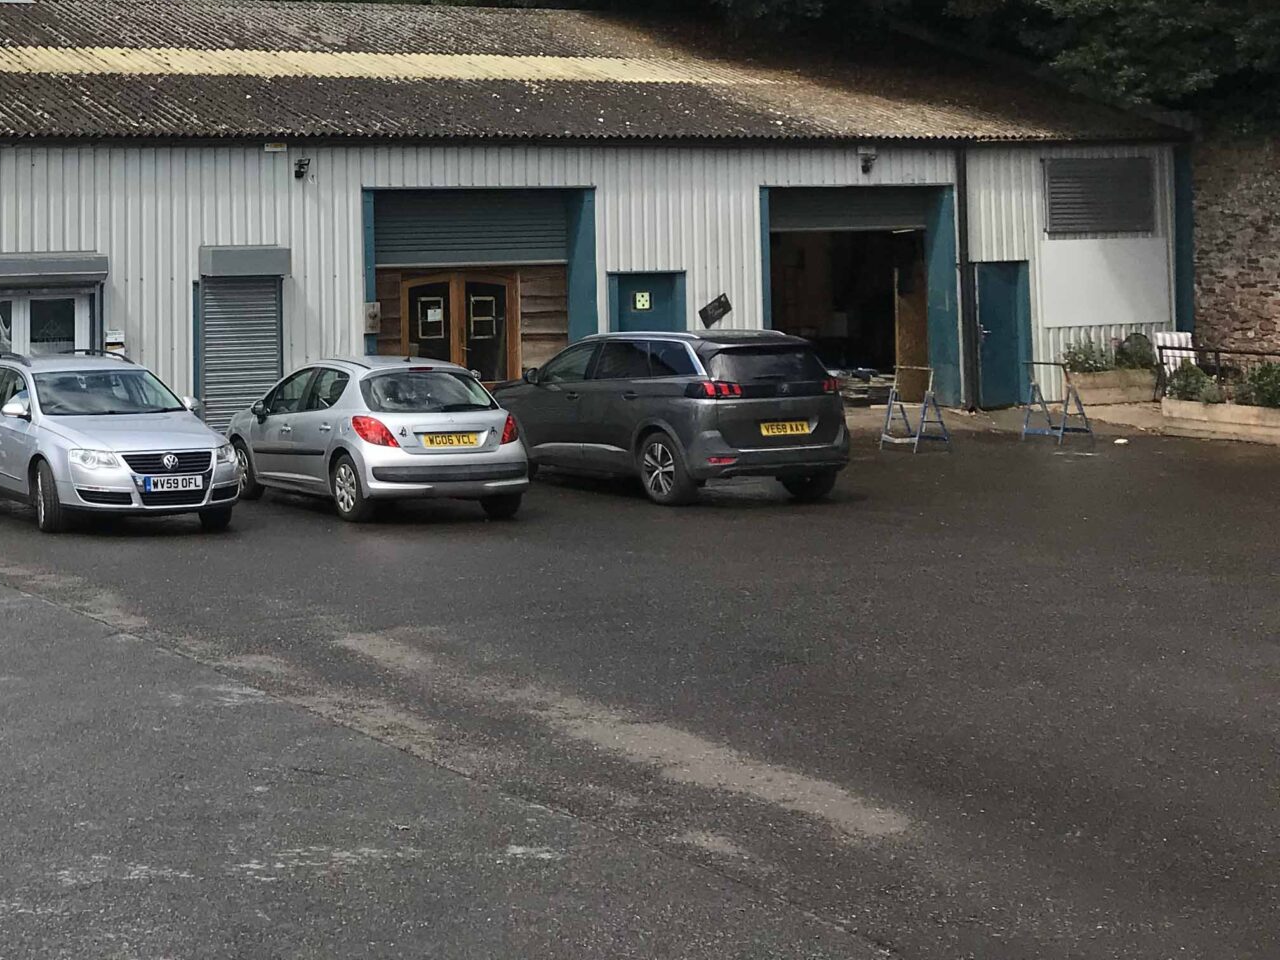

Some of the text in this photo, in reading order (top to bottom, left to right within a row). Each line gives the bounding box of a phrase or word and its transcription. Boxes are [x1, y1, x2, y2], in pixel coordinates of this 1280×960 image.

[428, 435, 454, 445] WG06
[152, 477, 201, 490] WV59 OFL
